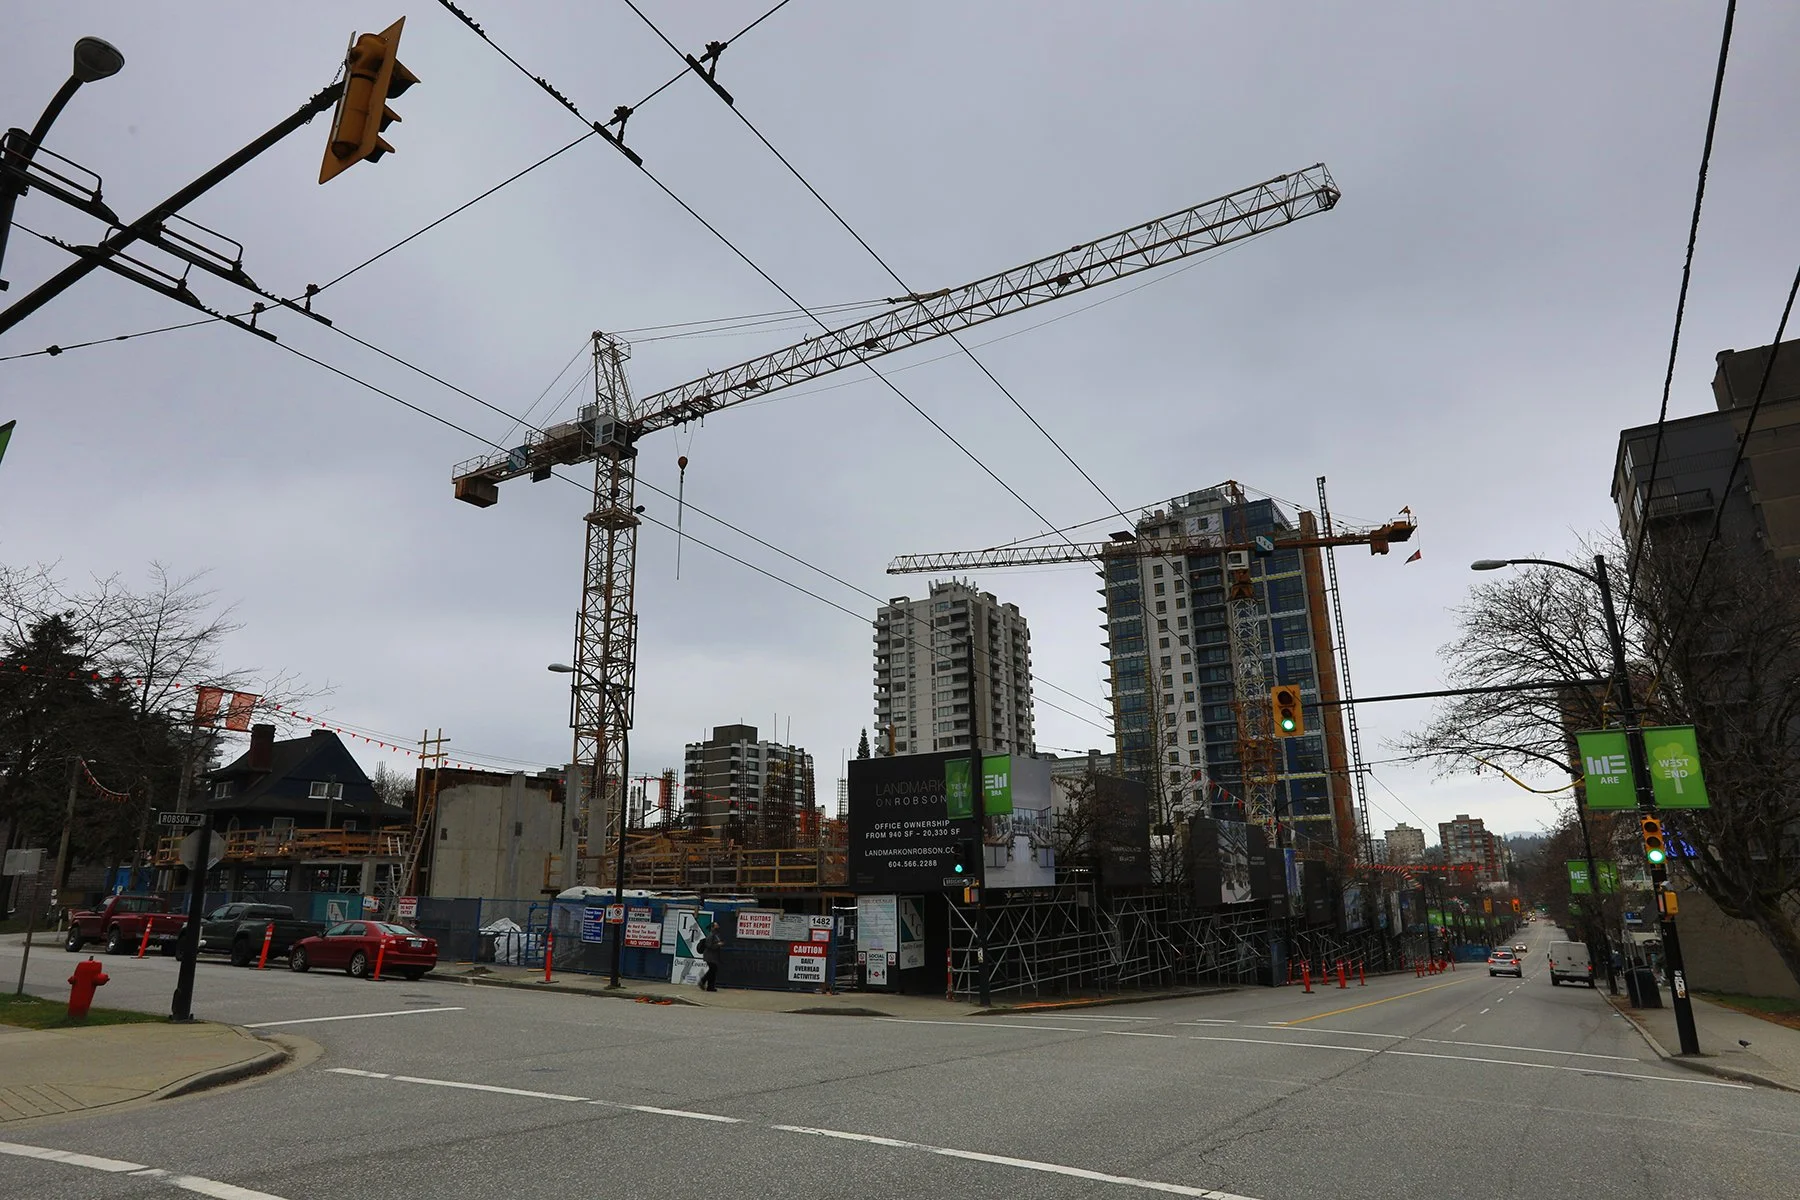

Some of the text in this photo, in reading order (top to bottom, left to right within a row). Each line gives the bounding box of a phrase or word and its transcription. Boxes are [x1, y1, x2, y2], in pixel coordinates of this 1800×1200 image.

[1586, 754, 1627, 775] WE
[1659, 758, 1689, 768] WEST
[1664, 769, 1688, 778] END
[1600, 776, 1620, 785] ARE
[876, 779, 946, 797] LANDMARK
[161, 814, 190, 824] ROBSON
[874, 819, 950, 831] OFFICE OWNERSHIP
[865, 831, 887, 840] FROM
[888, 830, 902, 839] 940
[904, 829, 914, 838] SF
[950, 826, 960, 836] SF
[888, 859, 938, 869] 604.566.2288
[812, 917, 831, 925] 1482
[903, 901, 922, 937] ITC
[793, 945, 823, 954] CAUTION
[794, 965, 820, 973] OVERHEAD
[793, 973, 820, 981] ACTIVITIES
